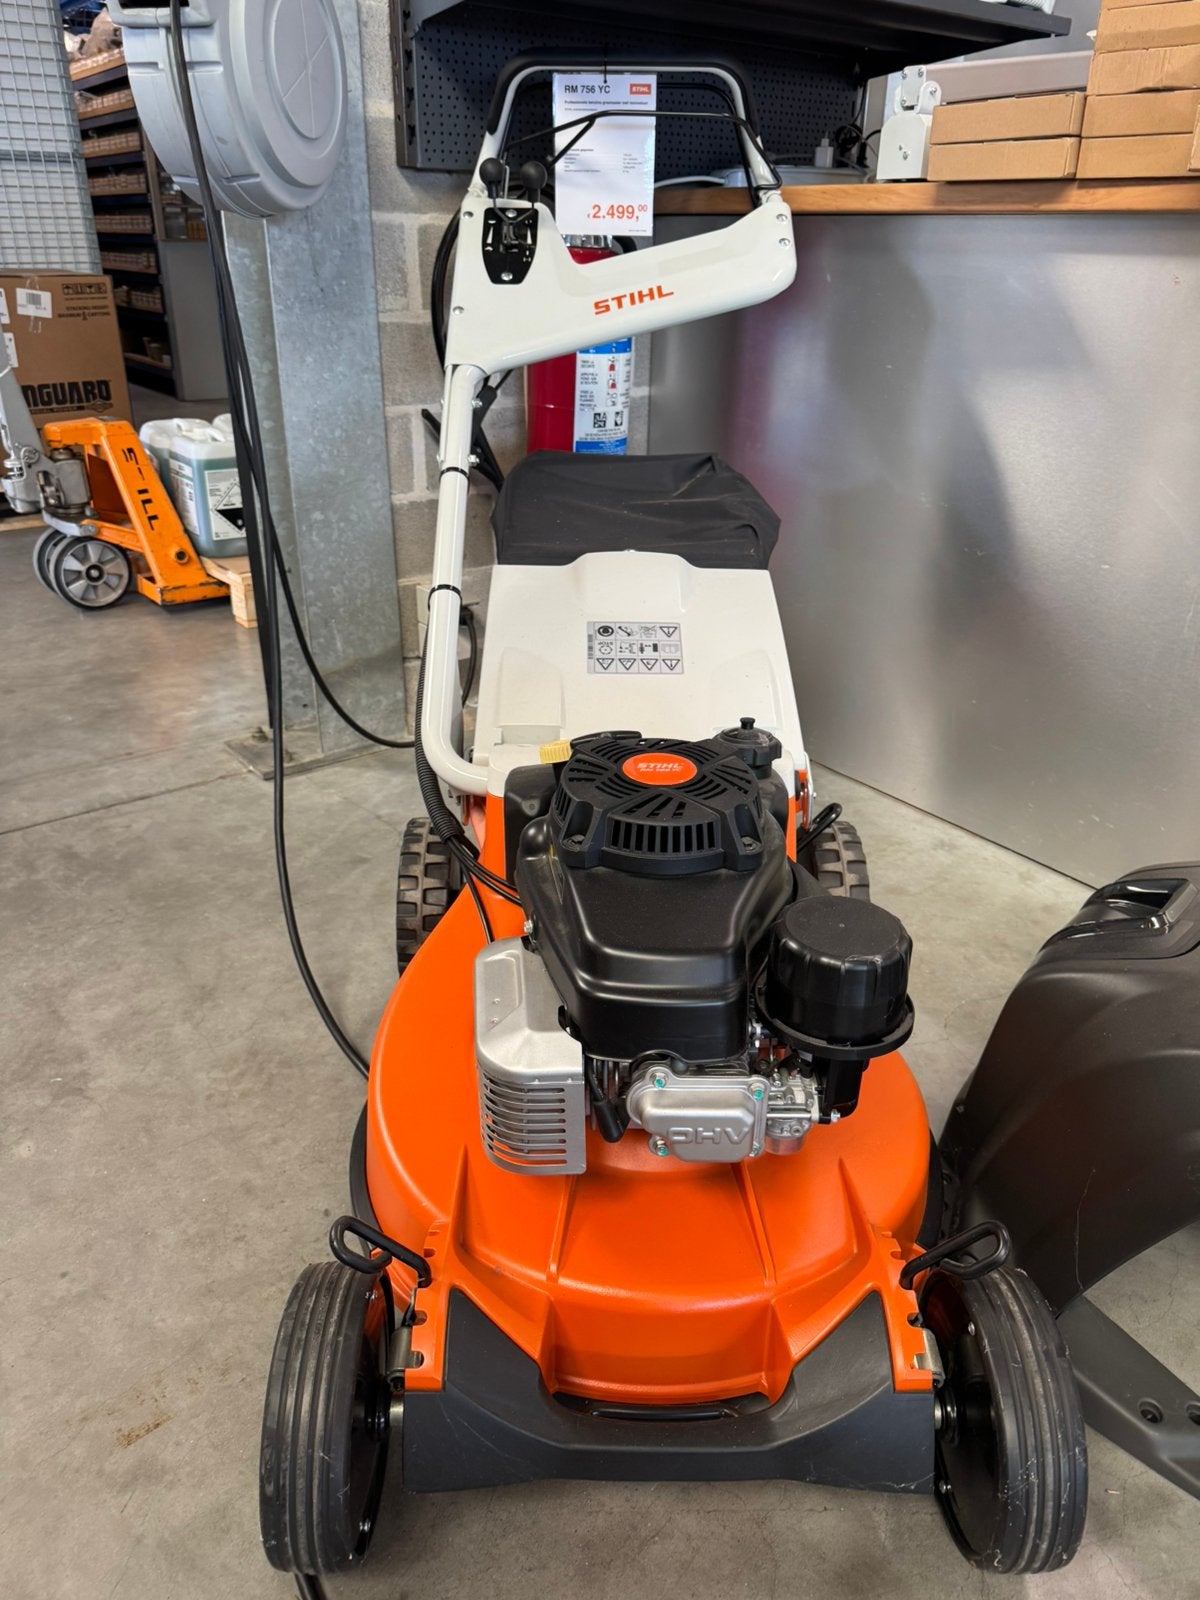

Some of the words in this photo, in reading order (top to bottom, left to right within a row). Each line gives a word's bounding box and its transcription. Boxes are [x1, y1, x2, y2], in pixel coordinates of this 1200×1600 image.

[564, 84, 578, 94] RM
[580, 84, 596, 94] 756
[598, 84, 611, 94] YC
[594, 285, 674, 315] STIHL
[21, 380, 112, 408] NGUARD
[666, 1127, 749, 1145] OHV
